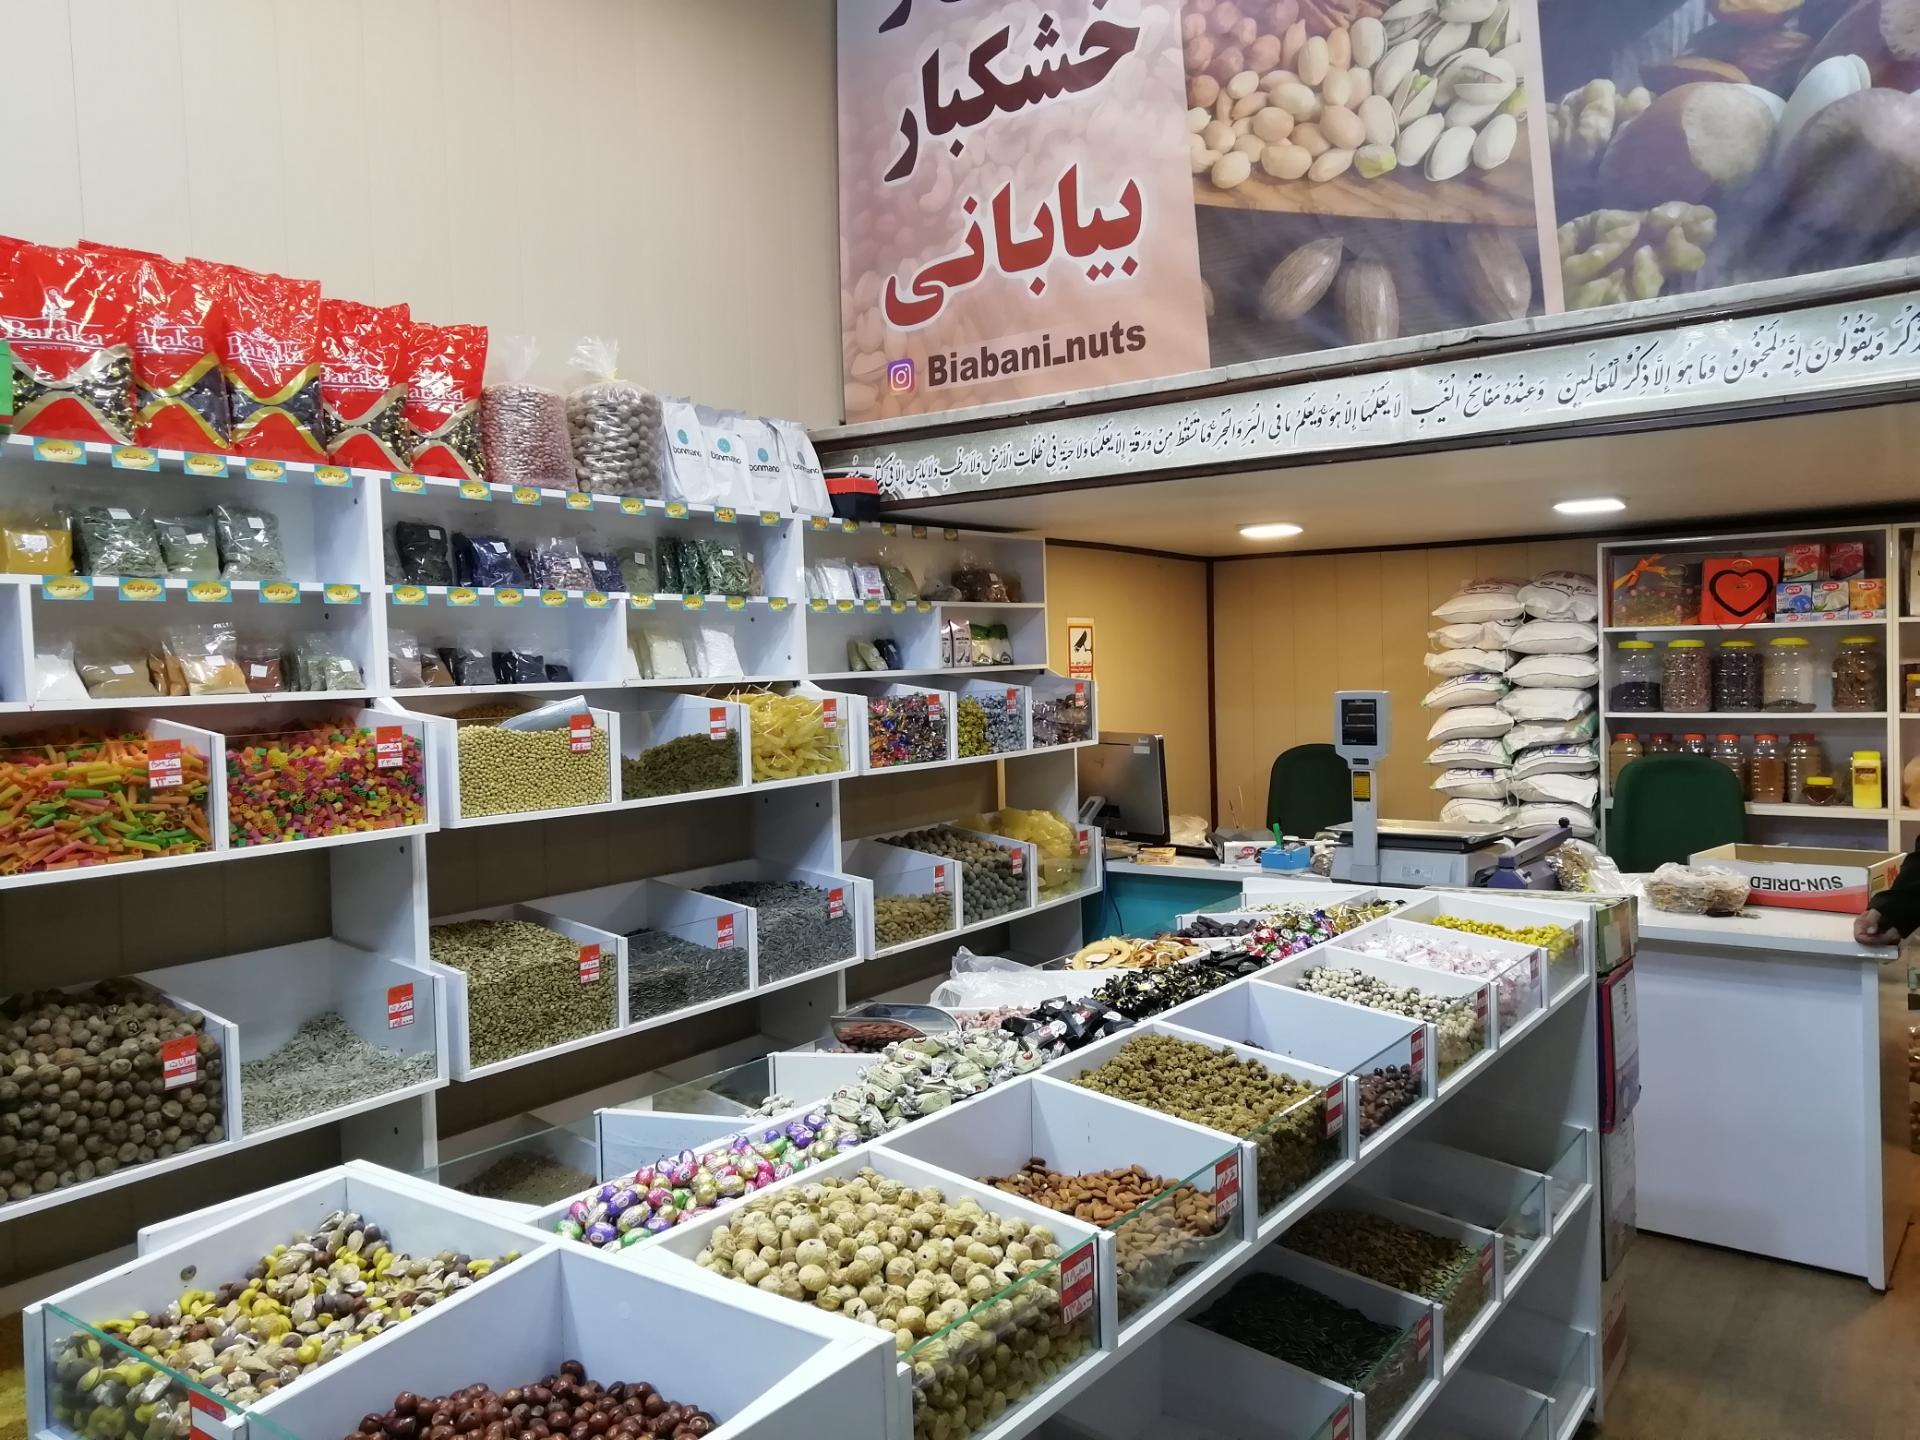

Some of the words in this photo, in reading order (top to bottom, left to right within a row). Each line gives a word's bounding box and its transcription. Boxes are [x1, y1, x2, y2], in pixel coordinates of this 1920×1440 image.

[882, 0, 1141, 182] خشکبار
[884, 162, 1143, 327] بیابانی
[4, 318, 104, 346] Baraka
[136, 328, 204, 349] araka
[226, 334, 306, 363] Baraka
[926, 319, 1147, 387] Biabani_nuts
[1750, 875, 1844, 892] SUN-DRIED
